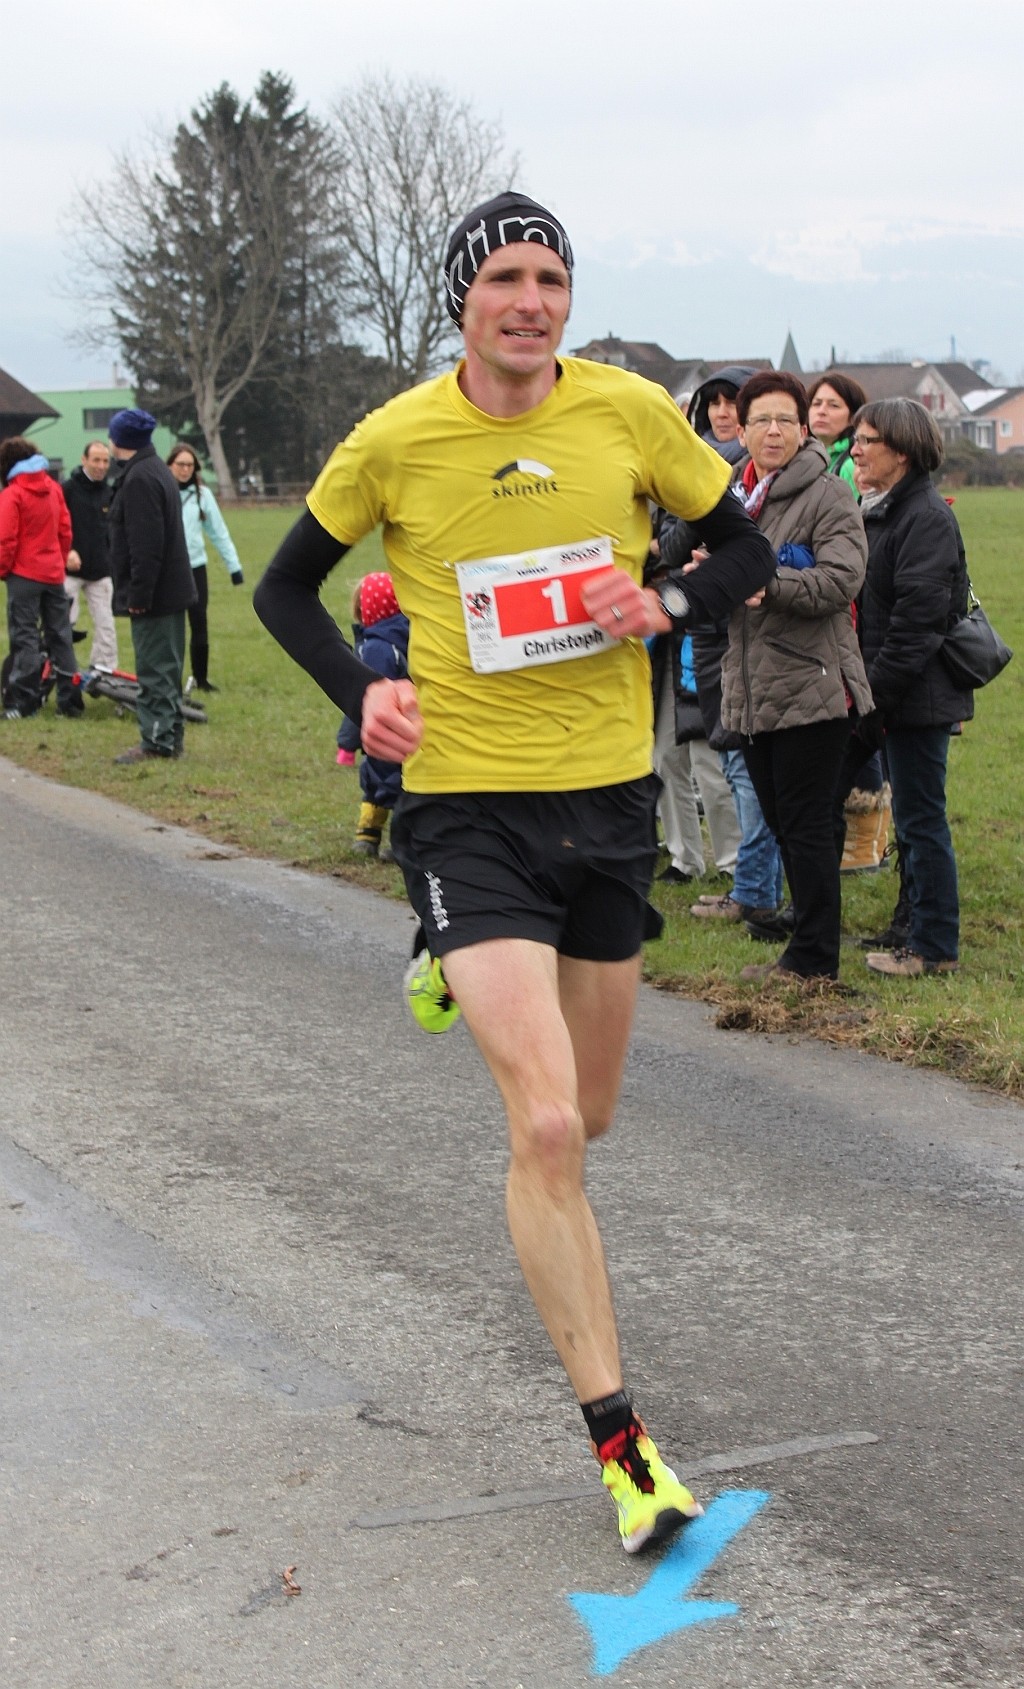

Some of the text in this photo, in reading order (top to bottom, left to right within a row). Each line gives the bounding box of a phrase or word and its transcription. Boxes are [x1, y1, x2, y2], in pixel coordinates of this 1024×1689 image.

[492, 481, 559, 498] skinfit
[541, 579, 569, 624] 1
[523, 630, 604, 657] Christoph
